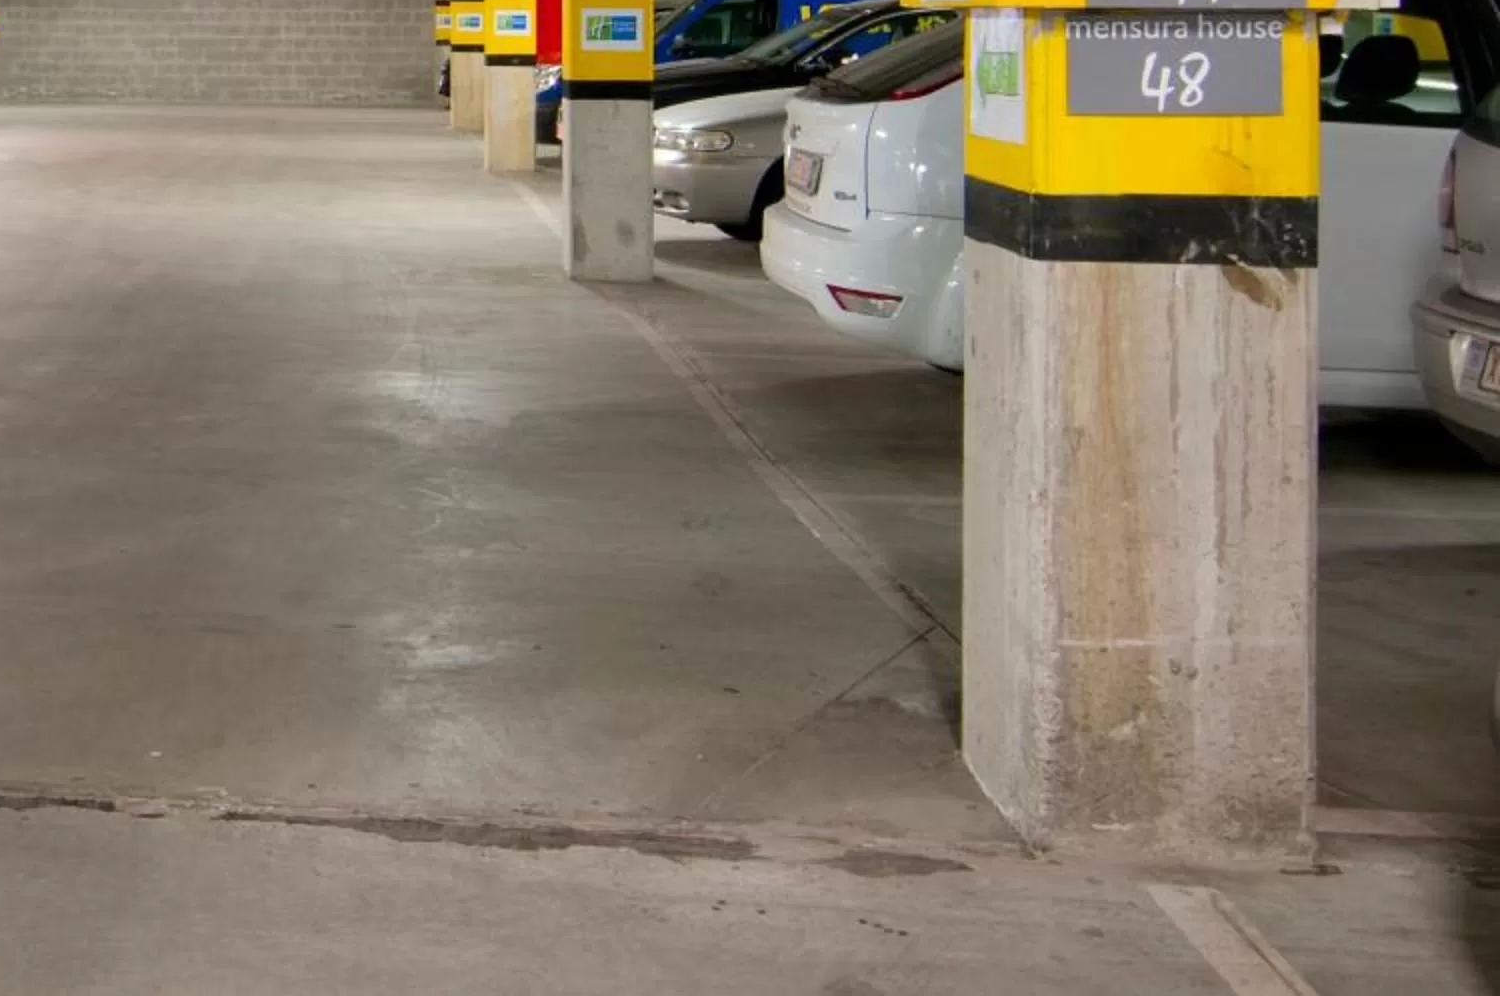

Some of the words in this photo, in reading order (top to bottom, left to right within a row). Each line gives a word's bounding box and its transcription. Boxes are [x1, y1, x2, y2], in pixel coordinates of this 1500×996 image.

[1065, 18, 1189, 40] mensura
[1197, 12, 1284, 40] house
[1141, 51, 1211, 113] 48
